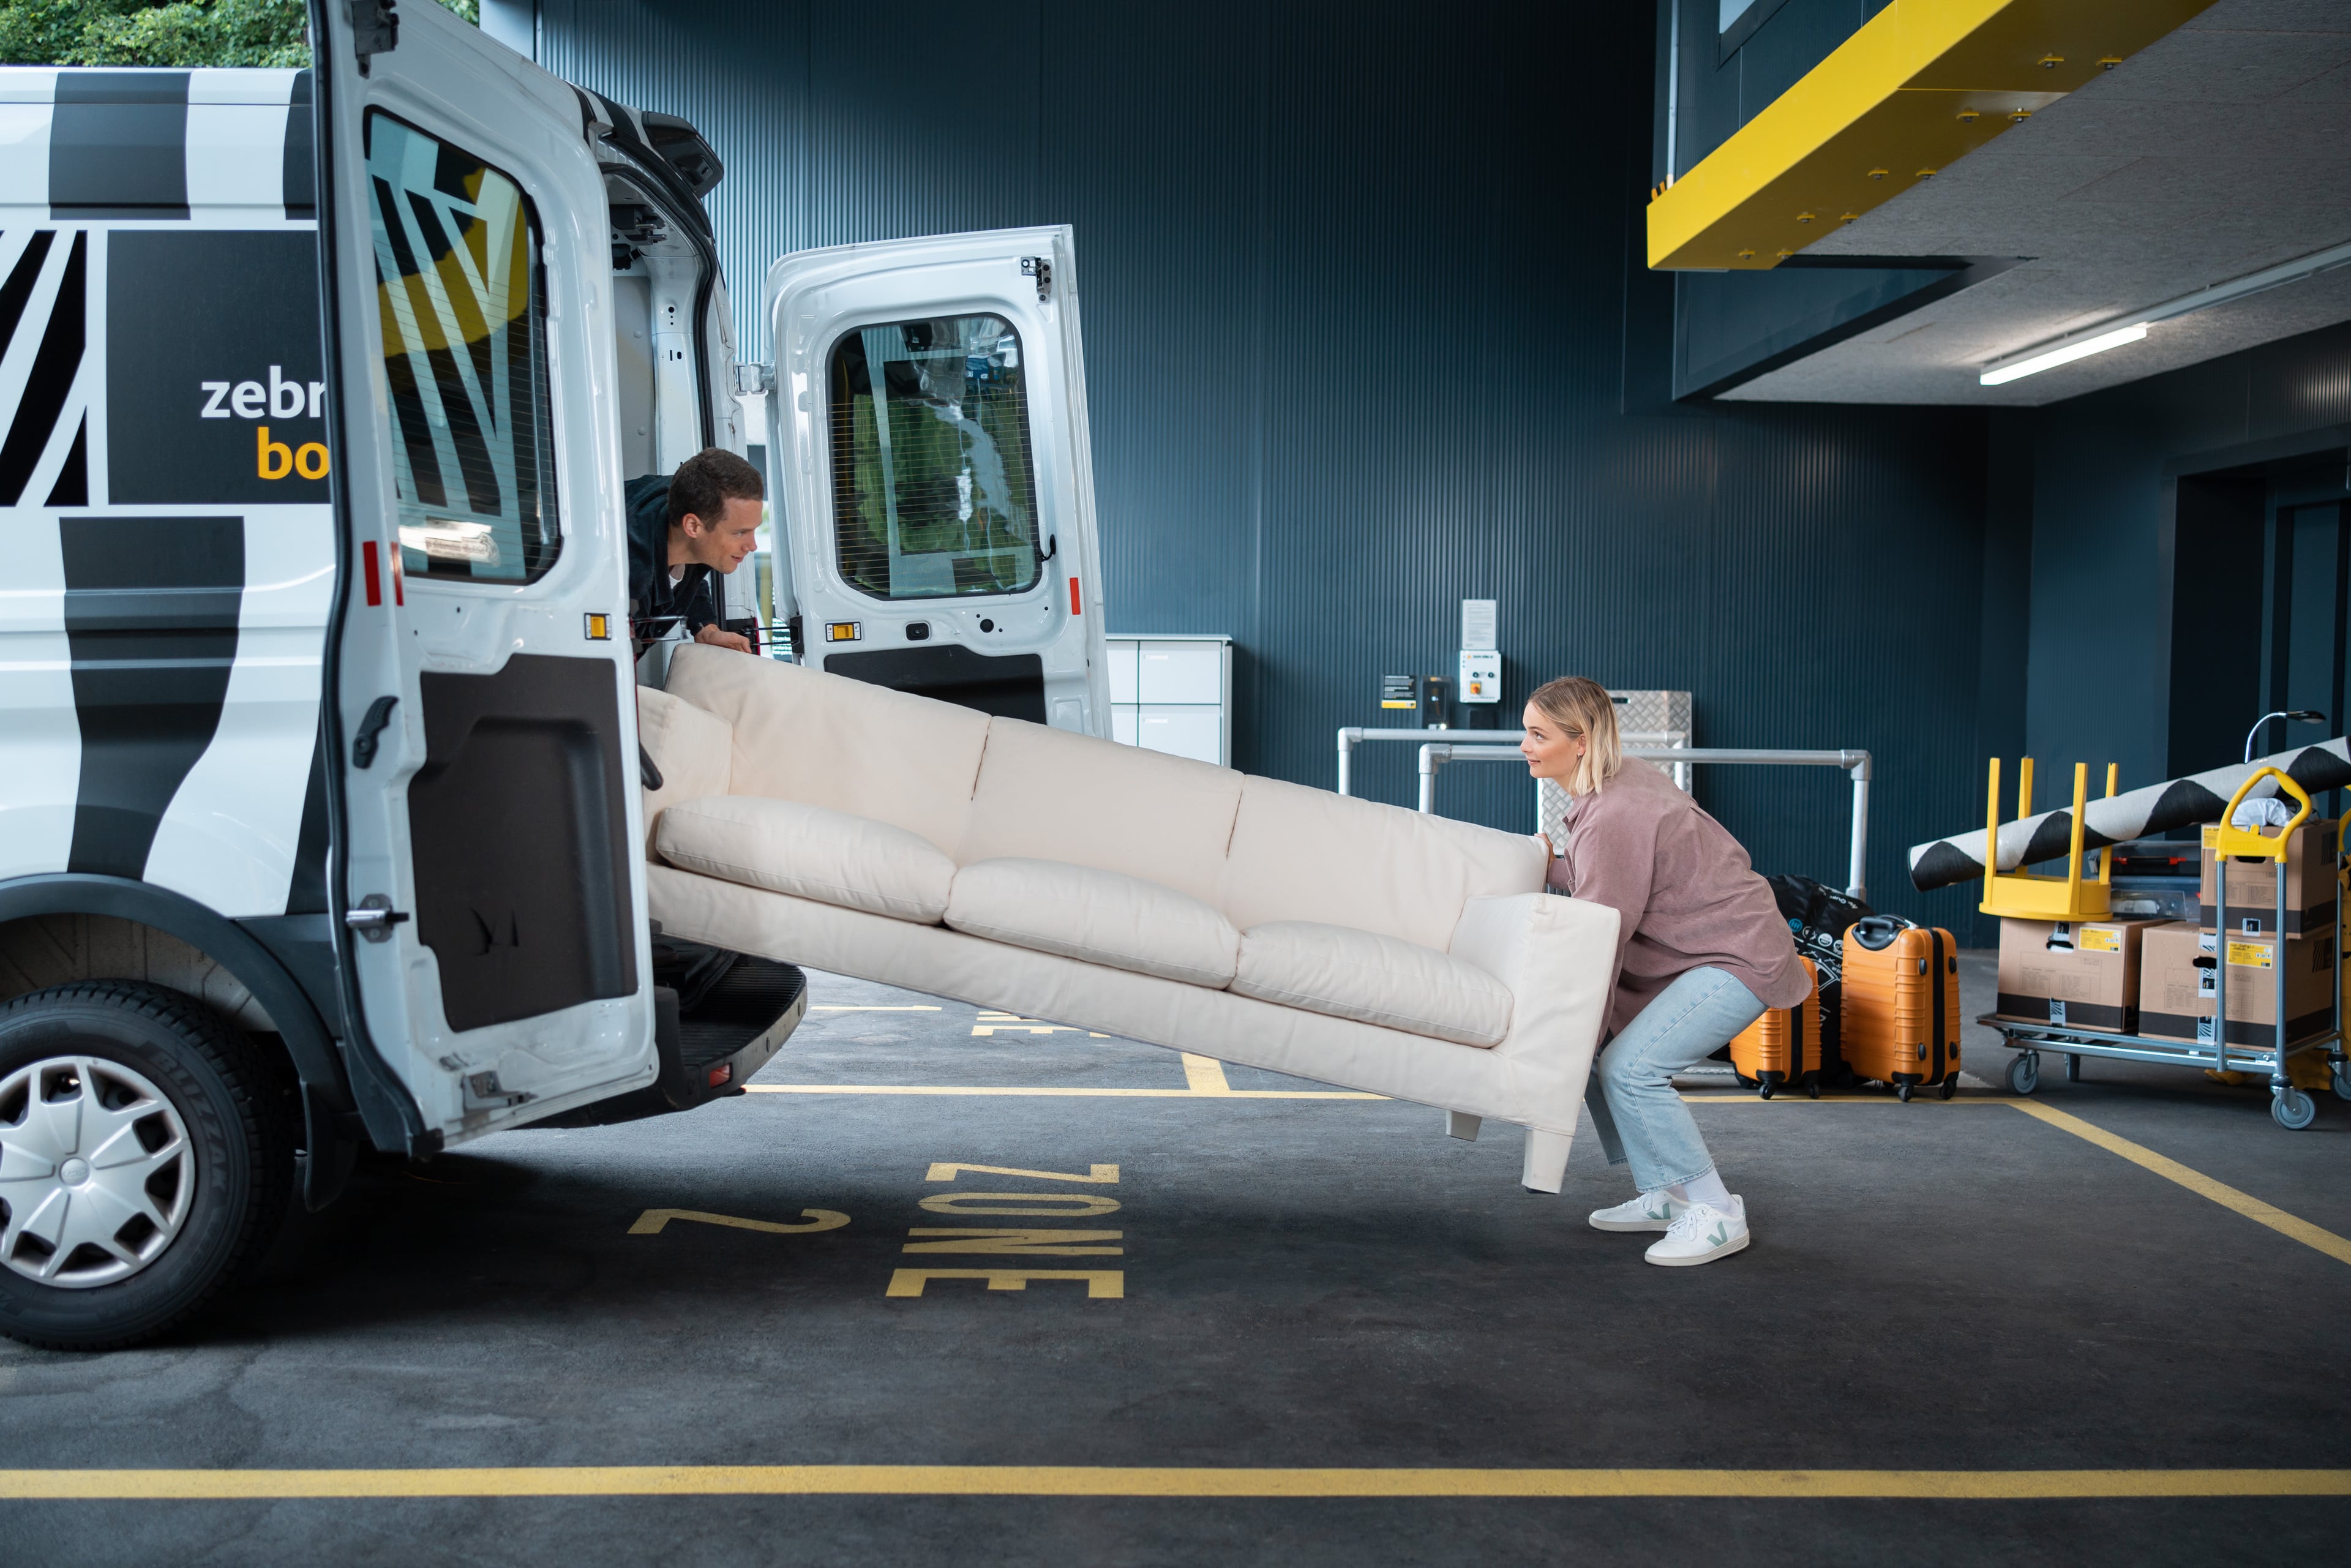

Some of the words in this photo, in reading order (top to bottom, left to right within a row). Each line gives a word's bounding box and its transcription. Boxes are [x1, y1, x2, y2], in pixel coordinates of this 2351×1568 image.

[201, 365, 326, 419] zebr
[257, 426, 331, 480] bo
[155, 1052, 228, 1190] BLIZZAK
[626, 1207, 852, 1234] 2
[885, 1161, 1124, 1299] ZONE
